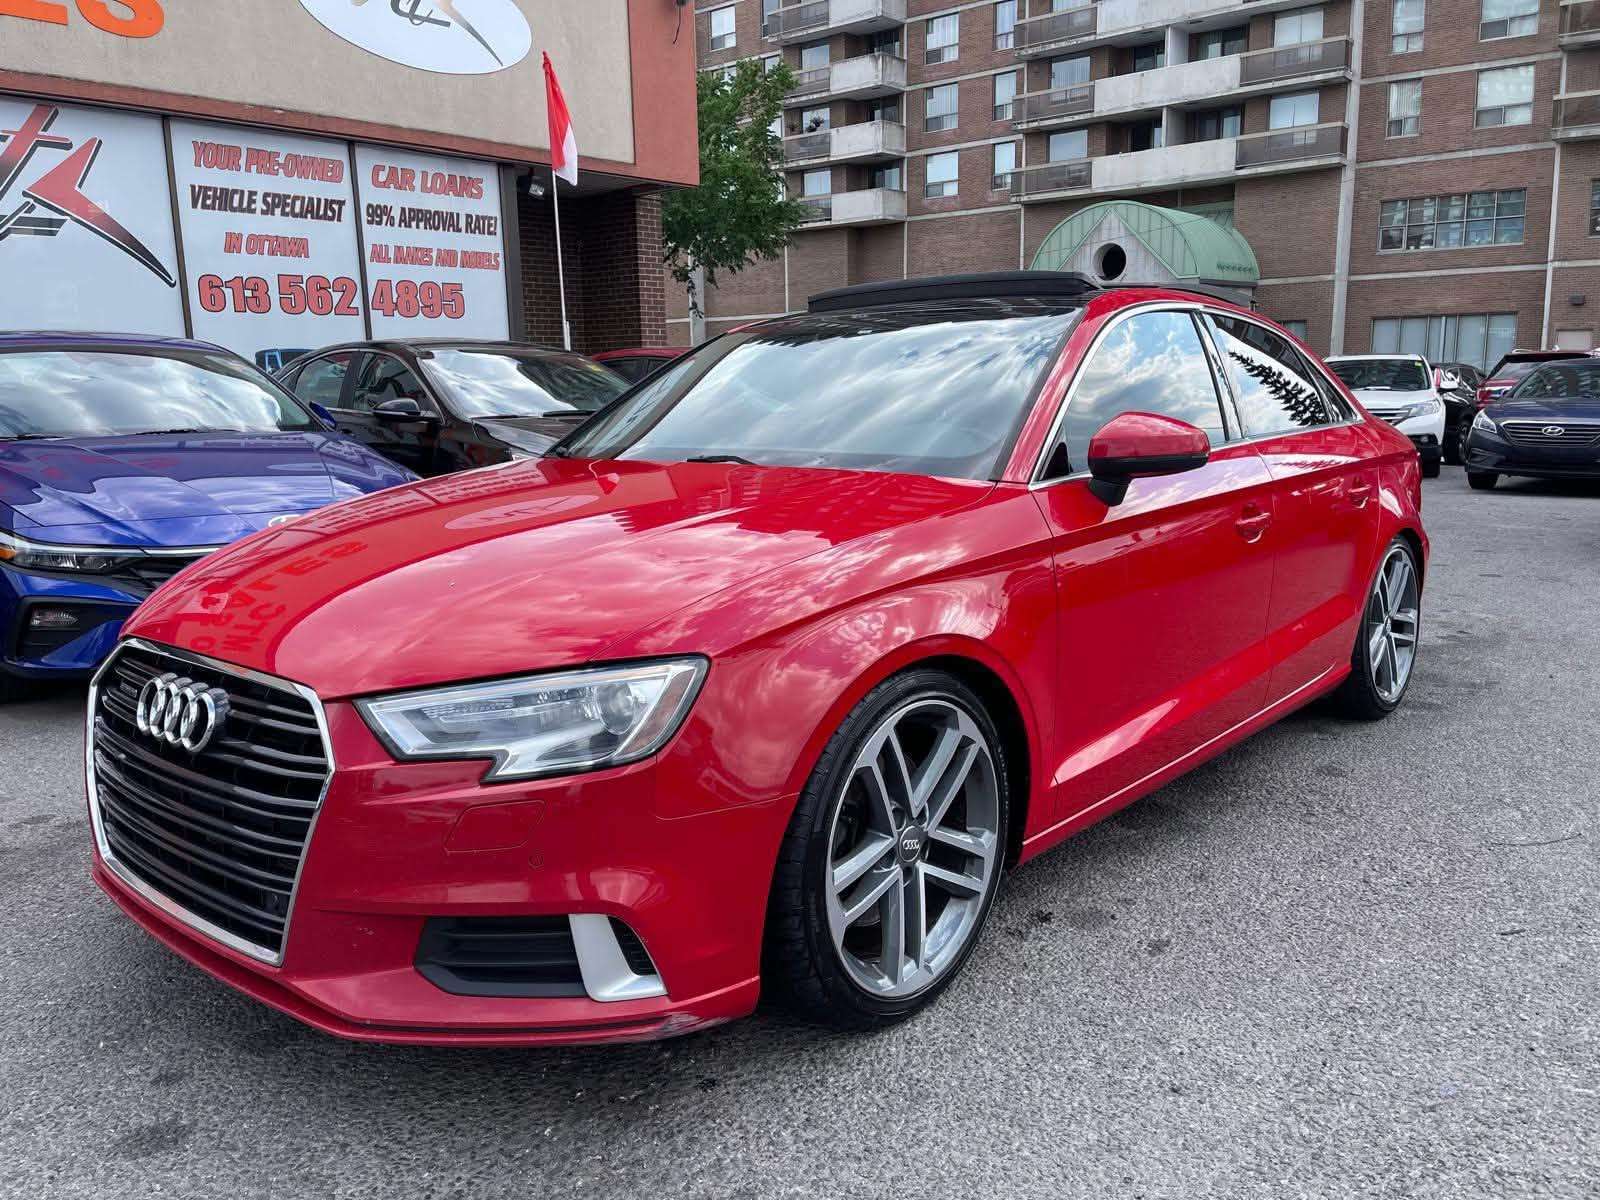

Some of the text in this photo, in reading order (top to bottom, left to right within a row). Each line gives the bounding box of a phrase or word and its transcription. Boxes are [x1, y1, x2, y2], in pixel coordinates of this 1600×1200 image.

[192, 140, 344, 183] YOUR PRE-OWNED
[371, 164, 484, 199] CAR LOANS
[190, 184, 346, 223] VEHICLE SPECIALIST
[366, 202, 498, 236] 99% APPROVAL RATE!
[223, 231, 310, 258] IN OTTAWA
[370, 243, 501, 271] ALL MAKES AND MODELS
[198, 273, 466, 319] 613 562 4895
